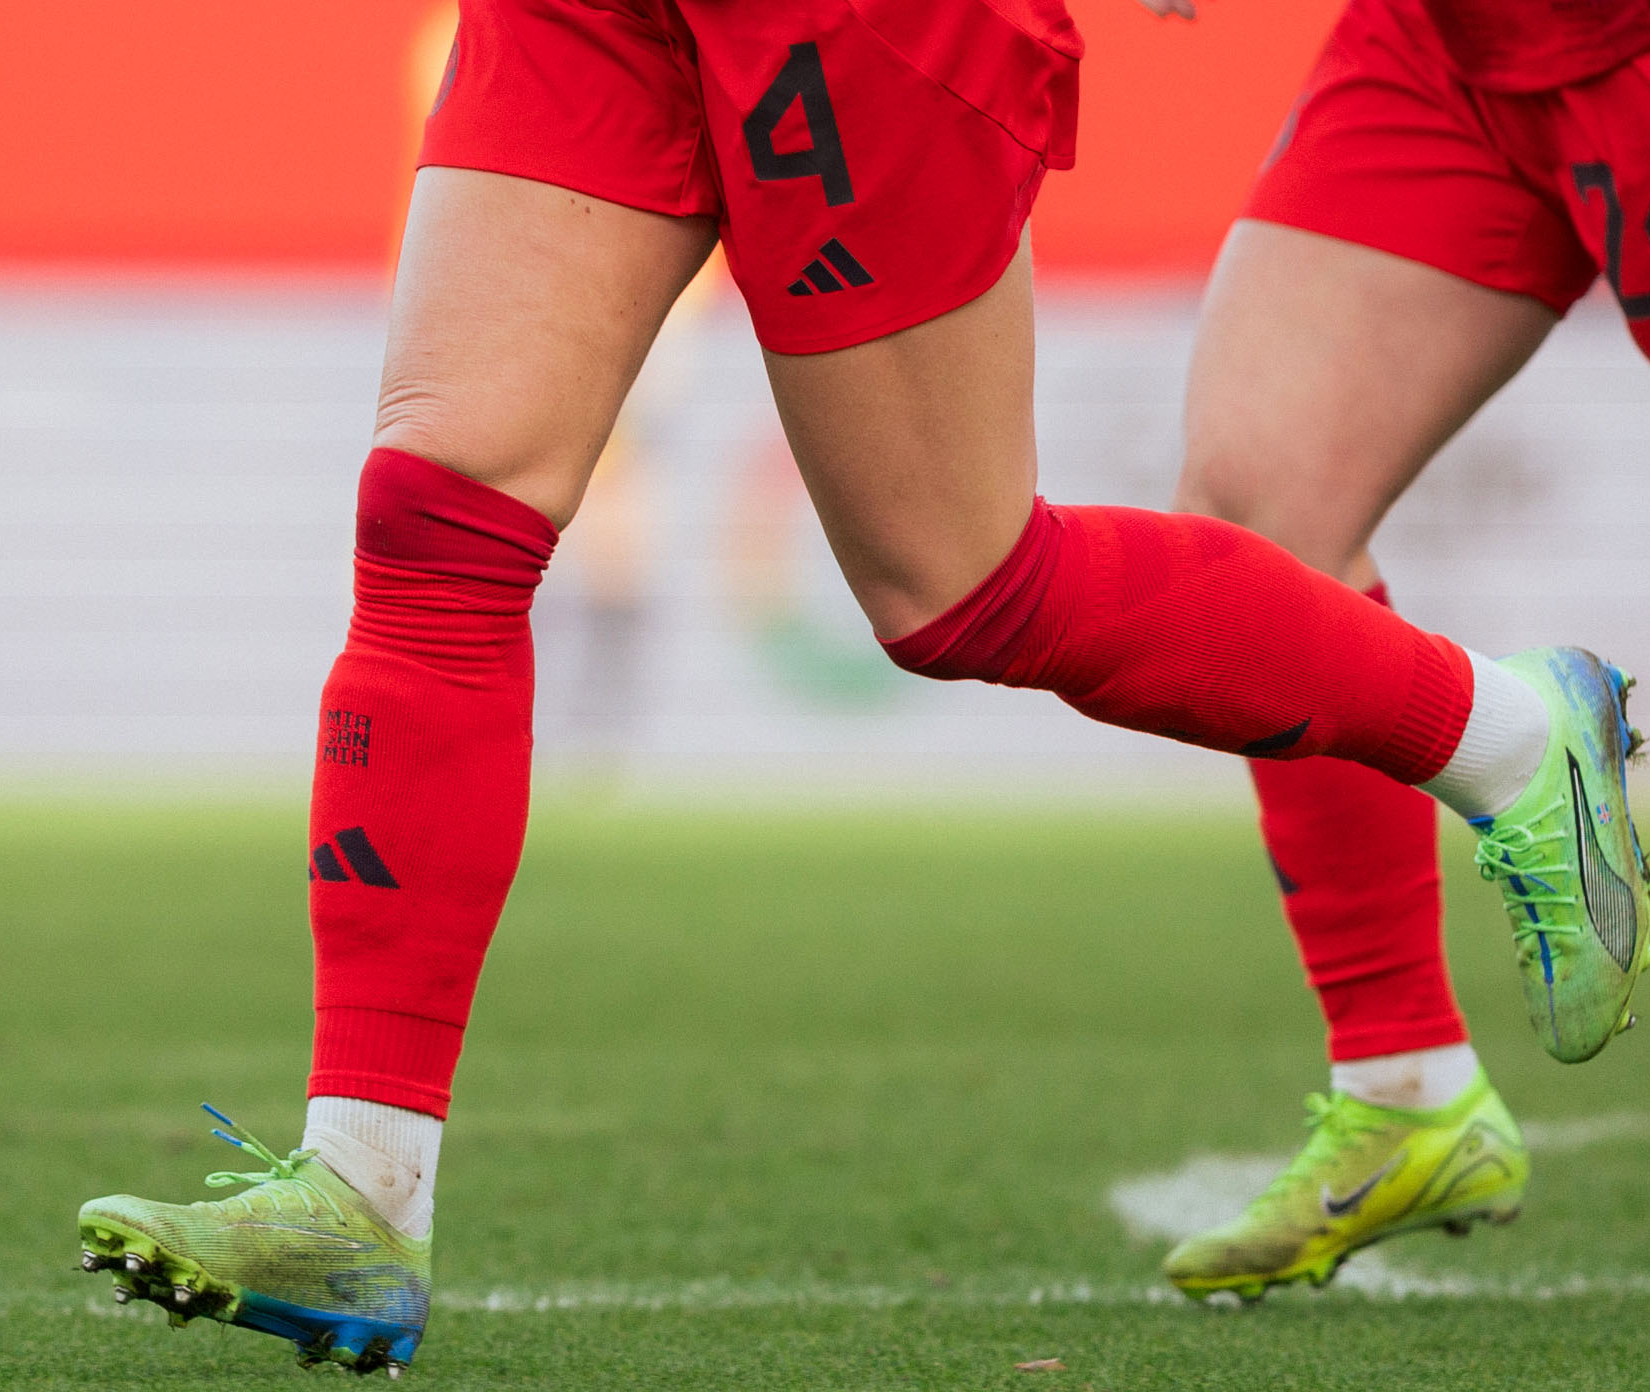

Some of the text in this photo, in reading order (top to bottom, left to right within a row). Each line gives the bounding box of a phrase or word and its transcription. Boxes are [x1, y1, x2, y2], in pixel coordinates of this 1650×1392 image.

[743, 41, 855, 207] 4
[326, 710, 371, 733] MIA
[327, 728, 370, 749] SAN
[323, 746, 368, 768] MIA
